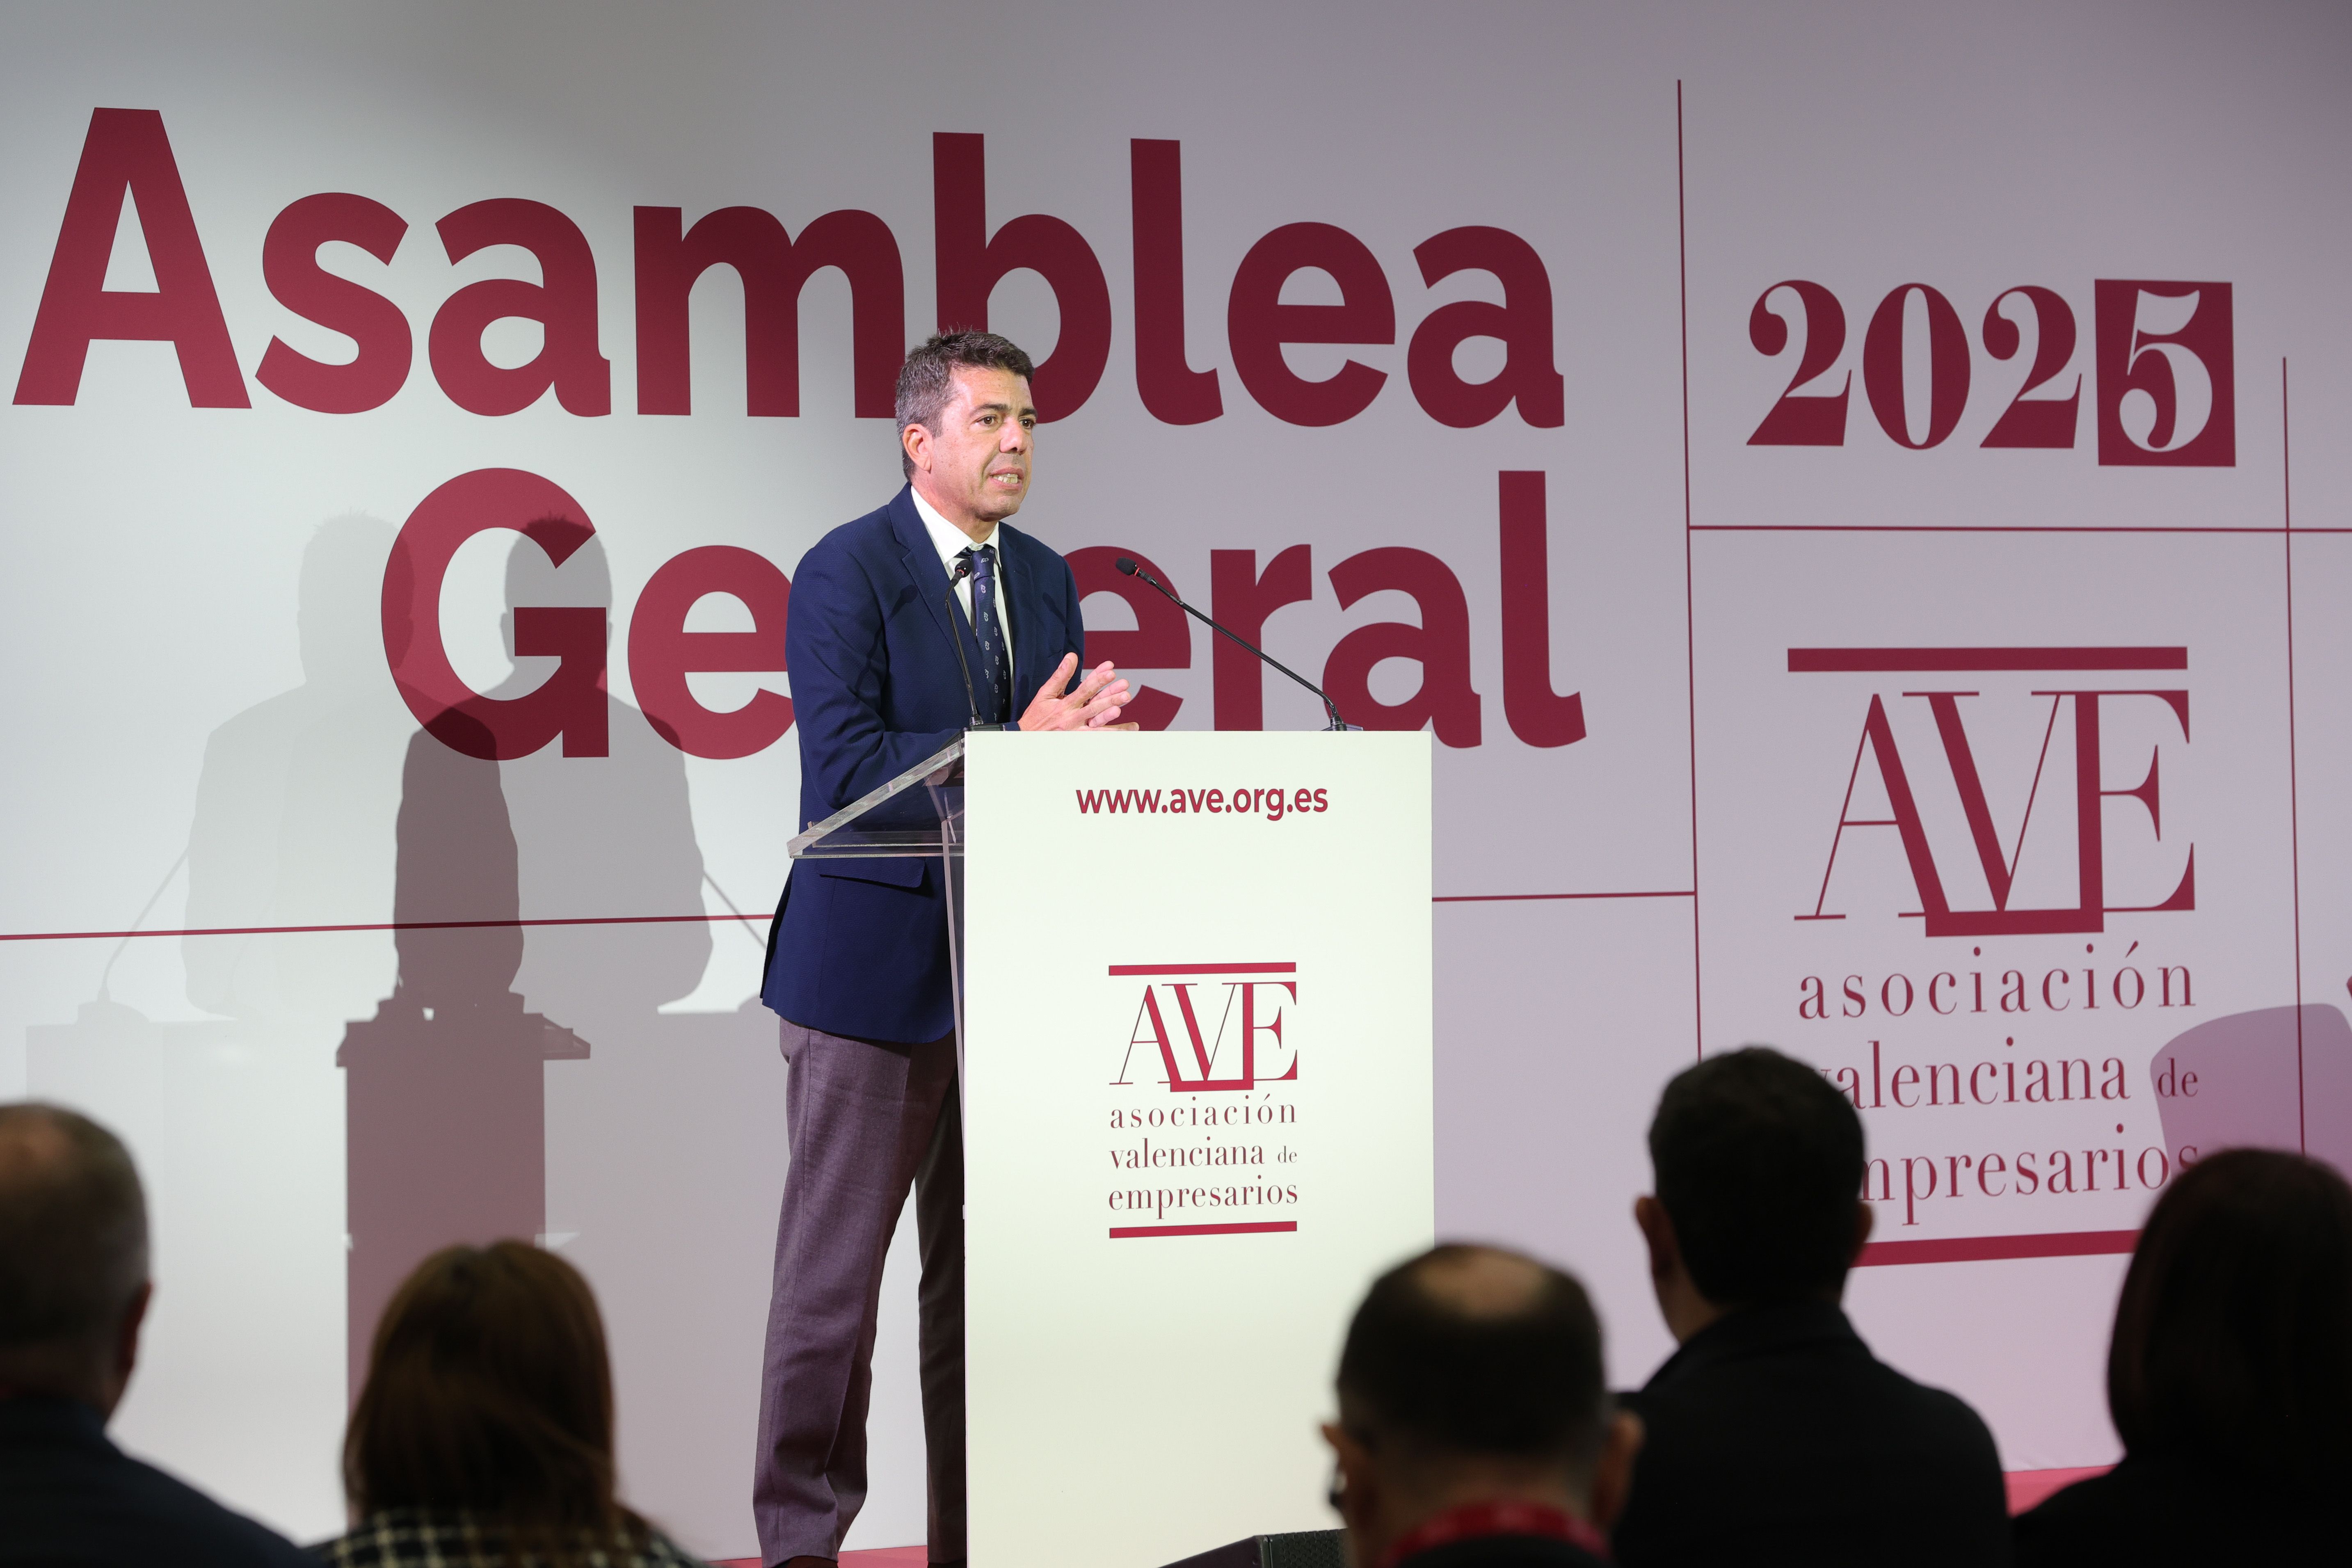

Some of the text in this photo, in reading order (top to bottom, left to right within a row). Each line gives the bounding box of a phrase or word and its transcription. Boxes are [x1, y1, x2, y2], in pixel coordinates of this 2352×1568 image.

[13, 107, 1565, 429] Asamblea
[1746, 279, 2213, 453] 2025
[382, 468, 1586, 759] Geeral
[1076, 788, 1328, 821] www.ave.org.es
[1794, 690, 2195, 937] AVE
[1799, 941, 2196, 1019] asociación
[1109, 981, 1298, 1093] AVE
[1821, 1036, 2199, 1110] alenciana de
[1109, 1136, 1298, 1170] valenciana de
[1110, 1094, 1298, 1129] asociación
[1109, 1175, 1298, 1220] empresarios
[1860, 1123, 2198, 1225] mpresarios
